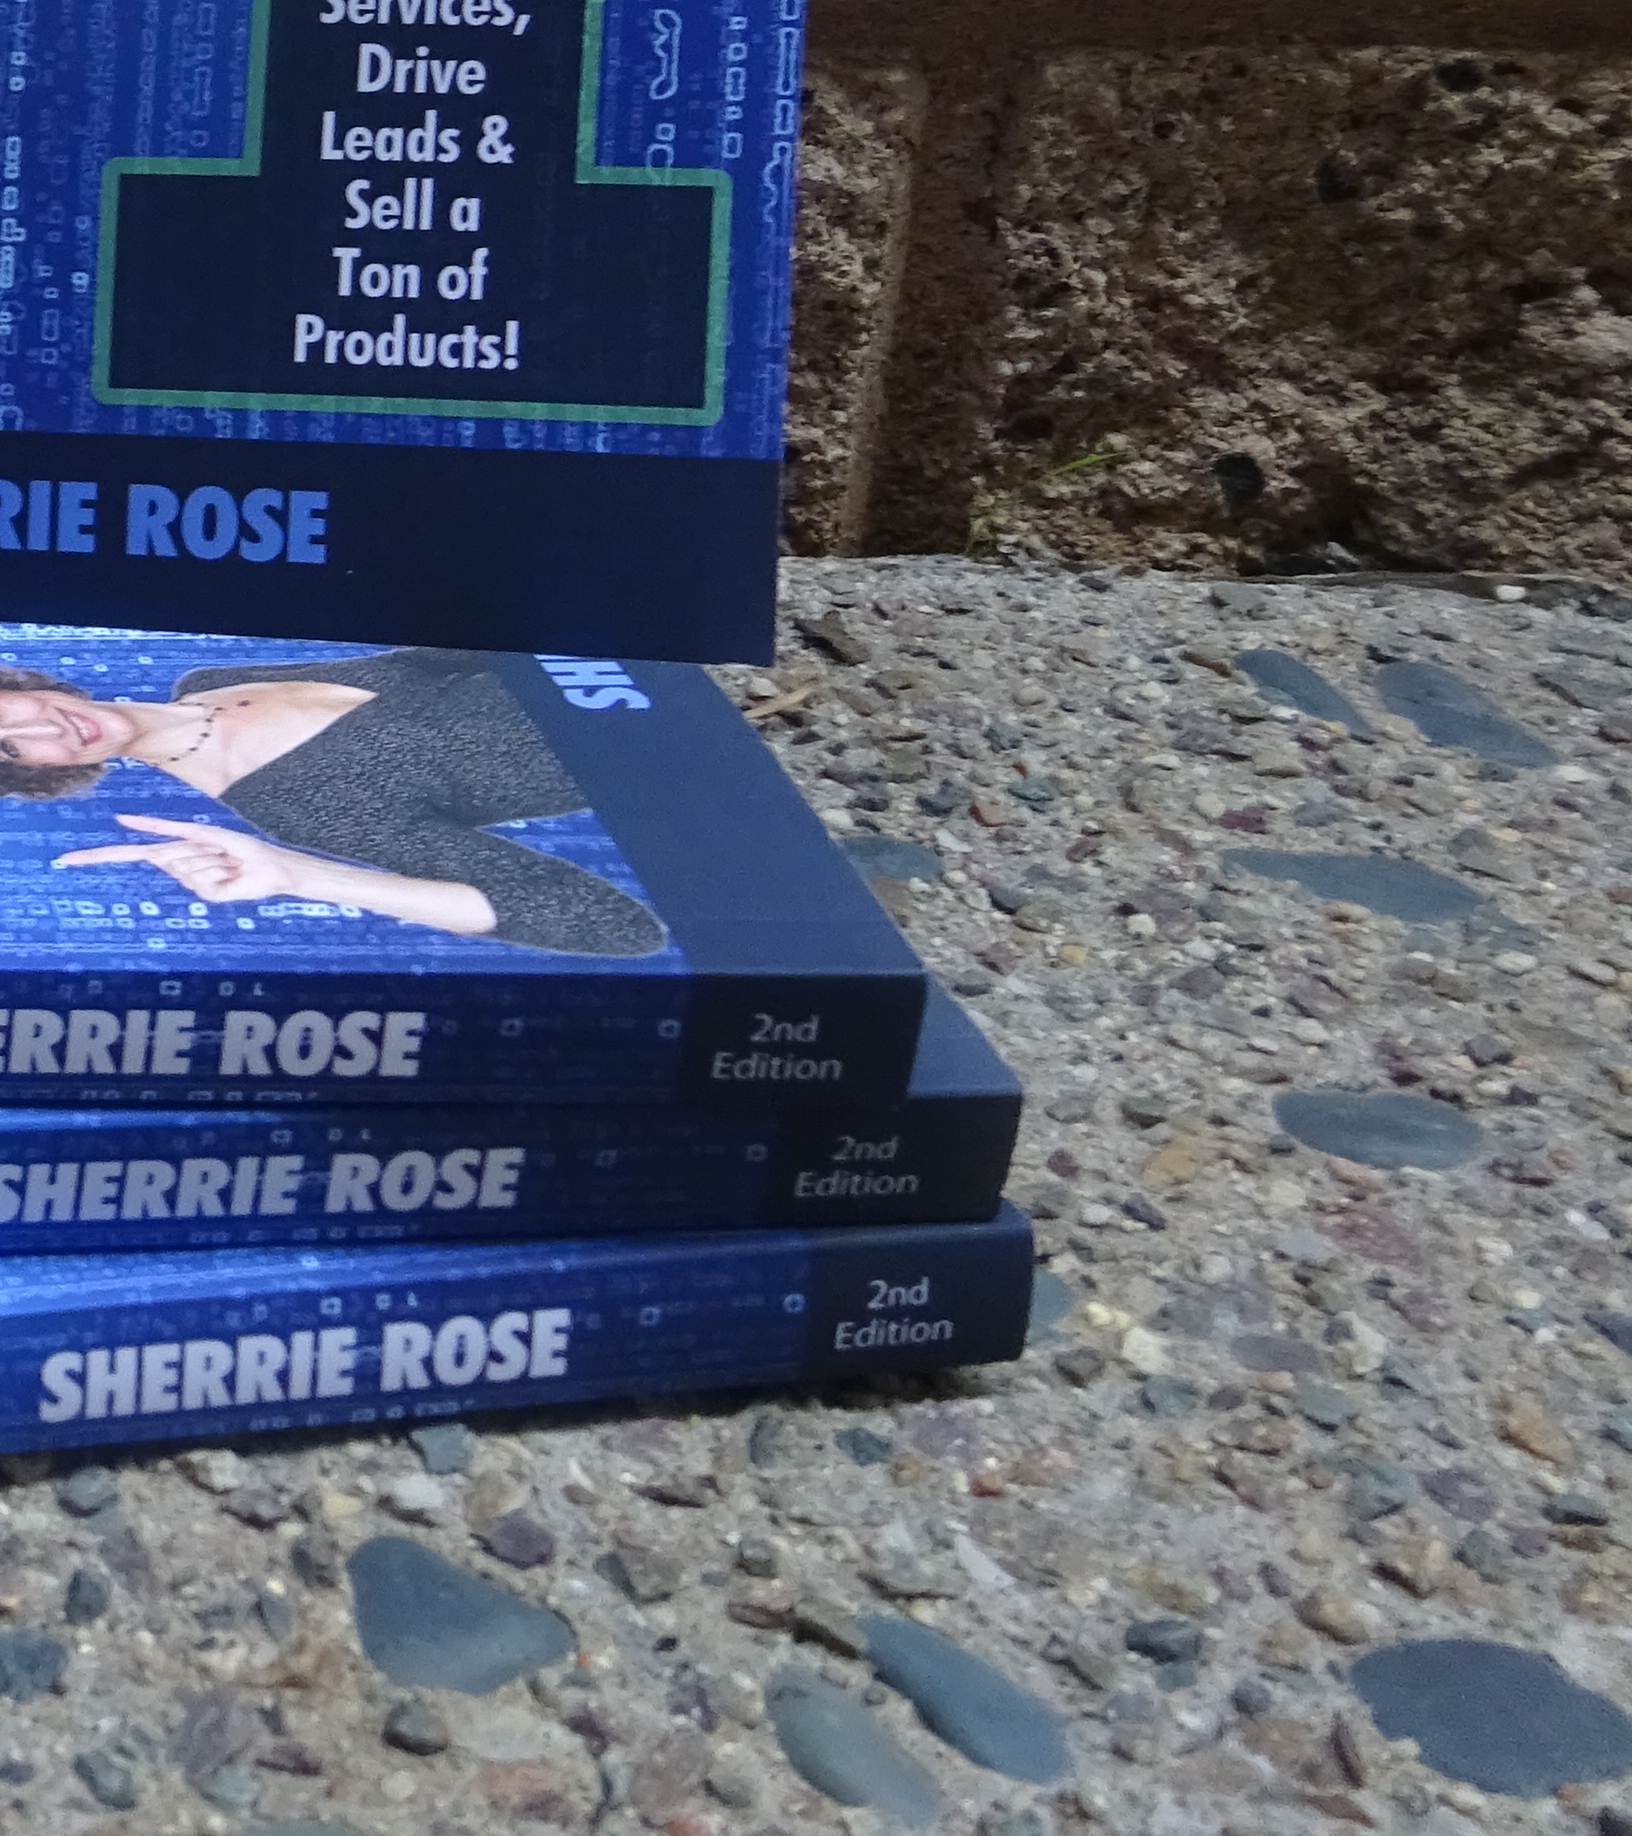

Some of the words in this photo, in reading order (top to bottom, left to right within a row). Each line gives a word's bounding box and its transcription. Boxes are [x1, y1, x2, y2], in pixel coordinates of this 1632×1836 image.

[355, 44, 487, 96] Drive
[320, 110, 461, 162] Leads
[476, 116, 515, 164] &
[343, 178, 435, 232] Sell
[449, 195, 480, 233] a
[332, 247, 422, 299] Ton
[436, 249, 489, 301] of
[294, 314, 521, 370] Products!
[126, 482, 330, 564] ROSE
[221, 1010, 428, 1078] ROSE
[750, 1012, 821, 1044] 2nd
[710, 1051, 844, 1081] Edition
[832, 1135, 901, 1163] 2nd
[324, 1147, 526, 1213] ROSE
[794, 1169, 921, 1199] Edition
[866, 1275, 931, 1311] 2nd
[834, 1317, 955, 1351] Edition
[38, 1324, 357, 1425] SHERRIE
[379, 1308, 573, 1394] ROSE
